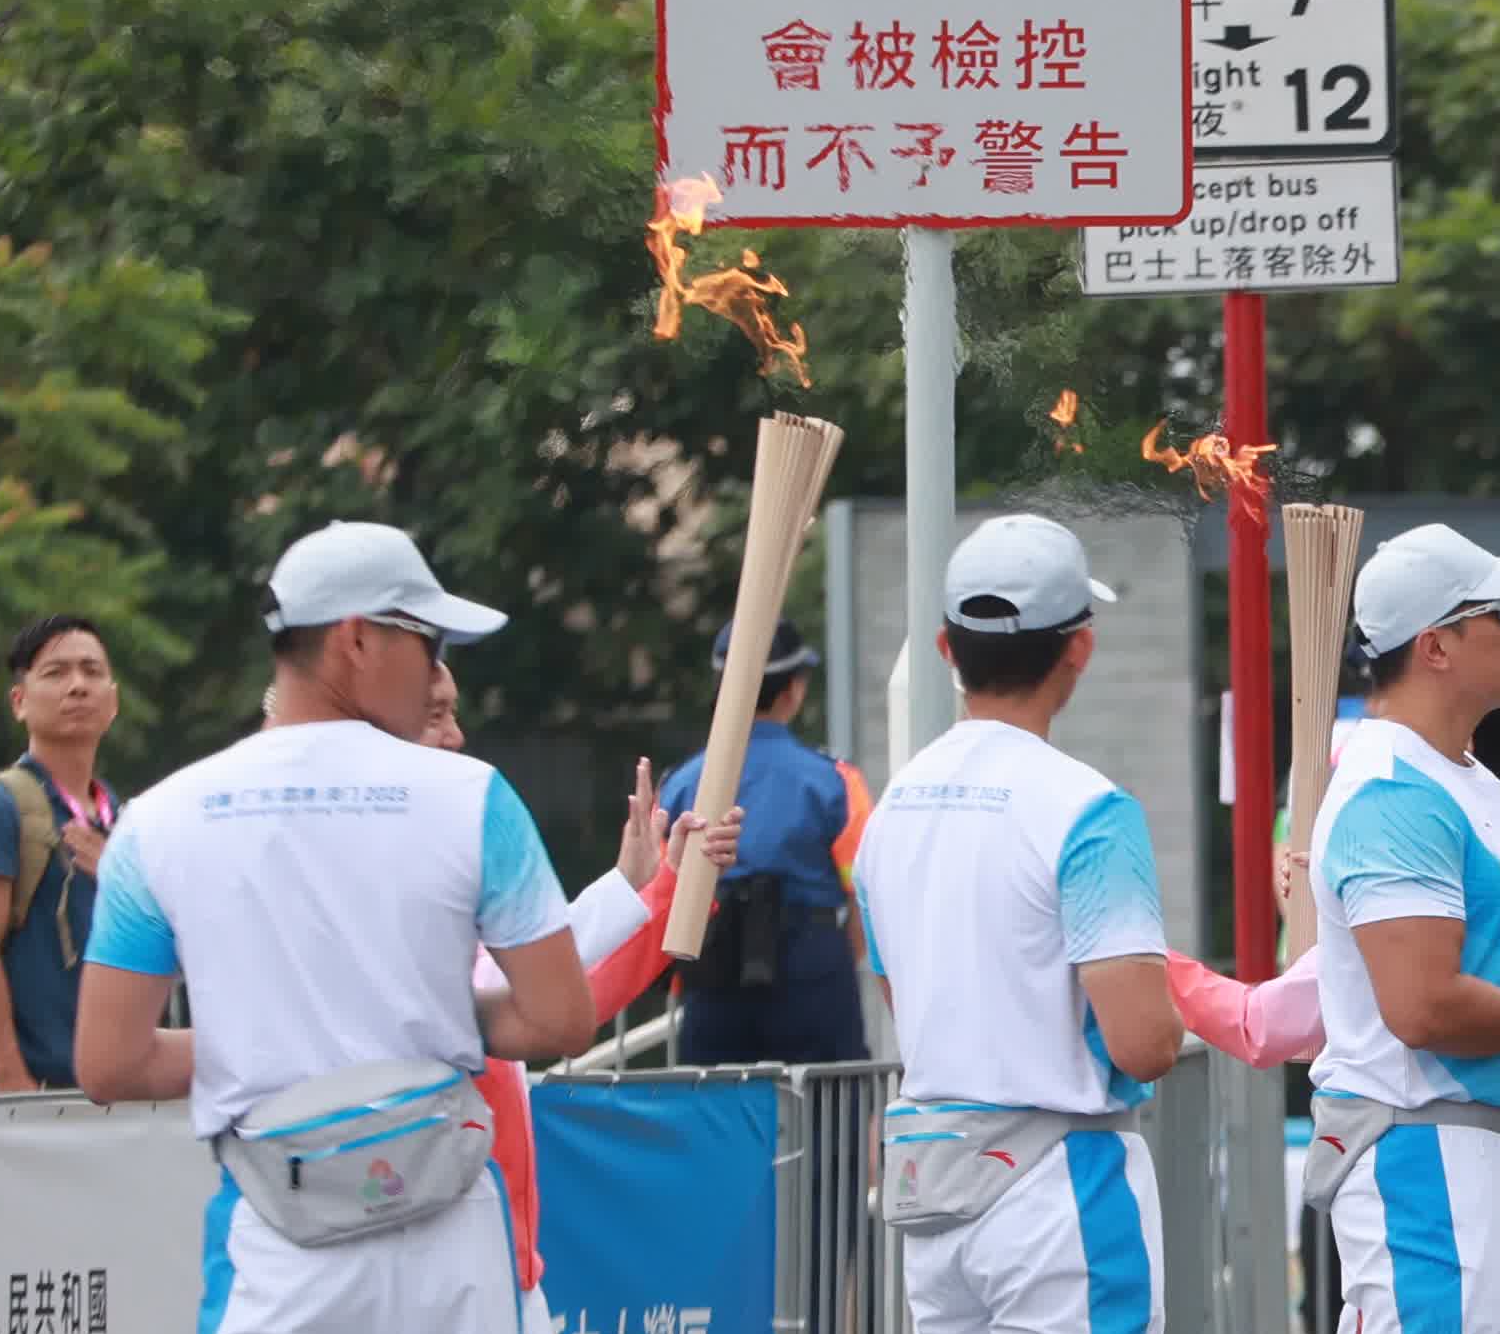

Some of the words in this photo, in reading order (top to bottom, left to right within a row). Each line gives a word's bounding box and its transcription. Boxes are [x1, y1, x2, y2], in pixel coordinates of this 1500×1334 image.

[761, 19, 1087, 91] 會被檢控
[1192, 60, 1261, 94] ight
[1284, 64, 1371, 133] 12
[1192, 101, 1227, 138] 夜
[720, 119, 1129, 194] 而不予警告
[1193, 176, 1255, 203] cept
[1268, 173, 1318, 197] bus
[1190, 208, 1307, 239] up/drop
[1317, 207, 1359, 231] off
[1106, 241, 1376, 283] 巴士上落客除外
